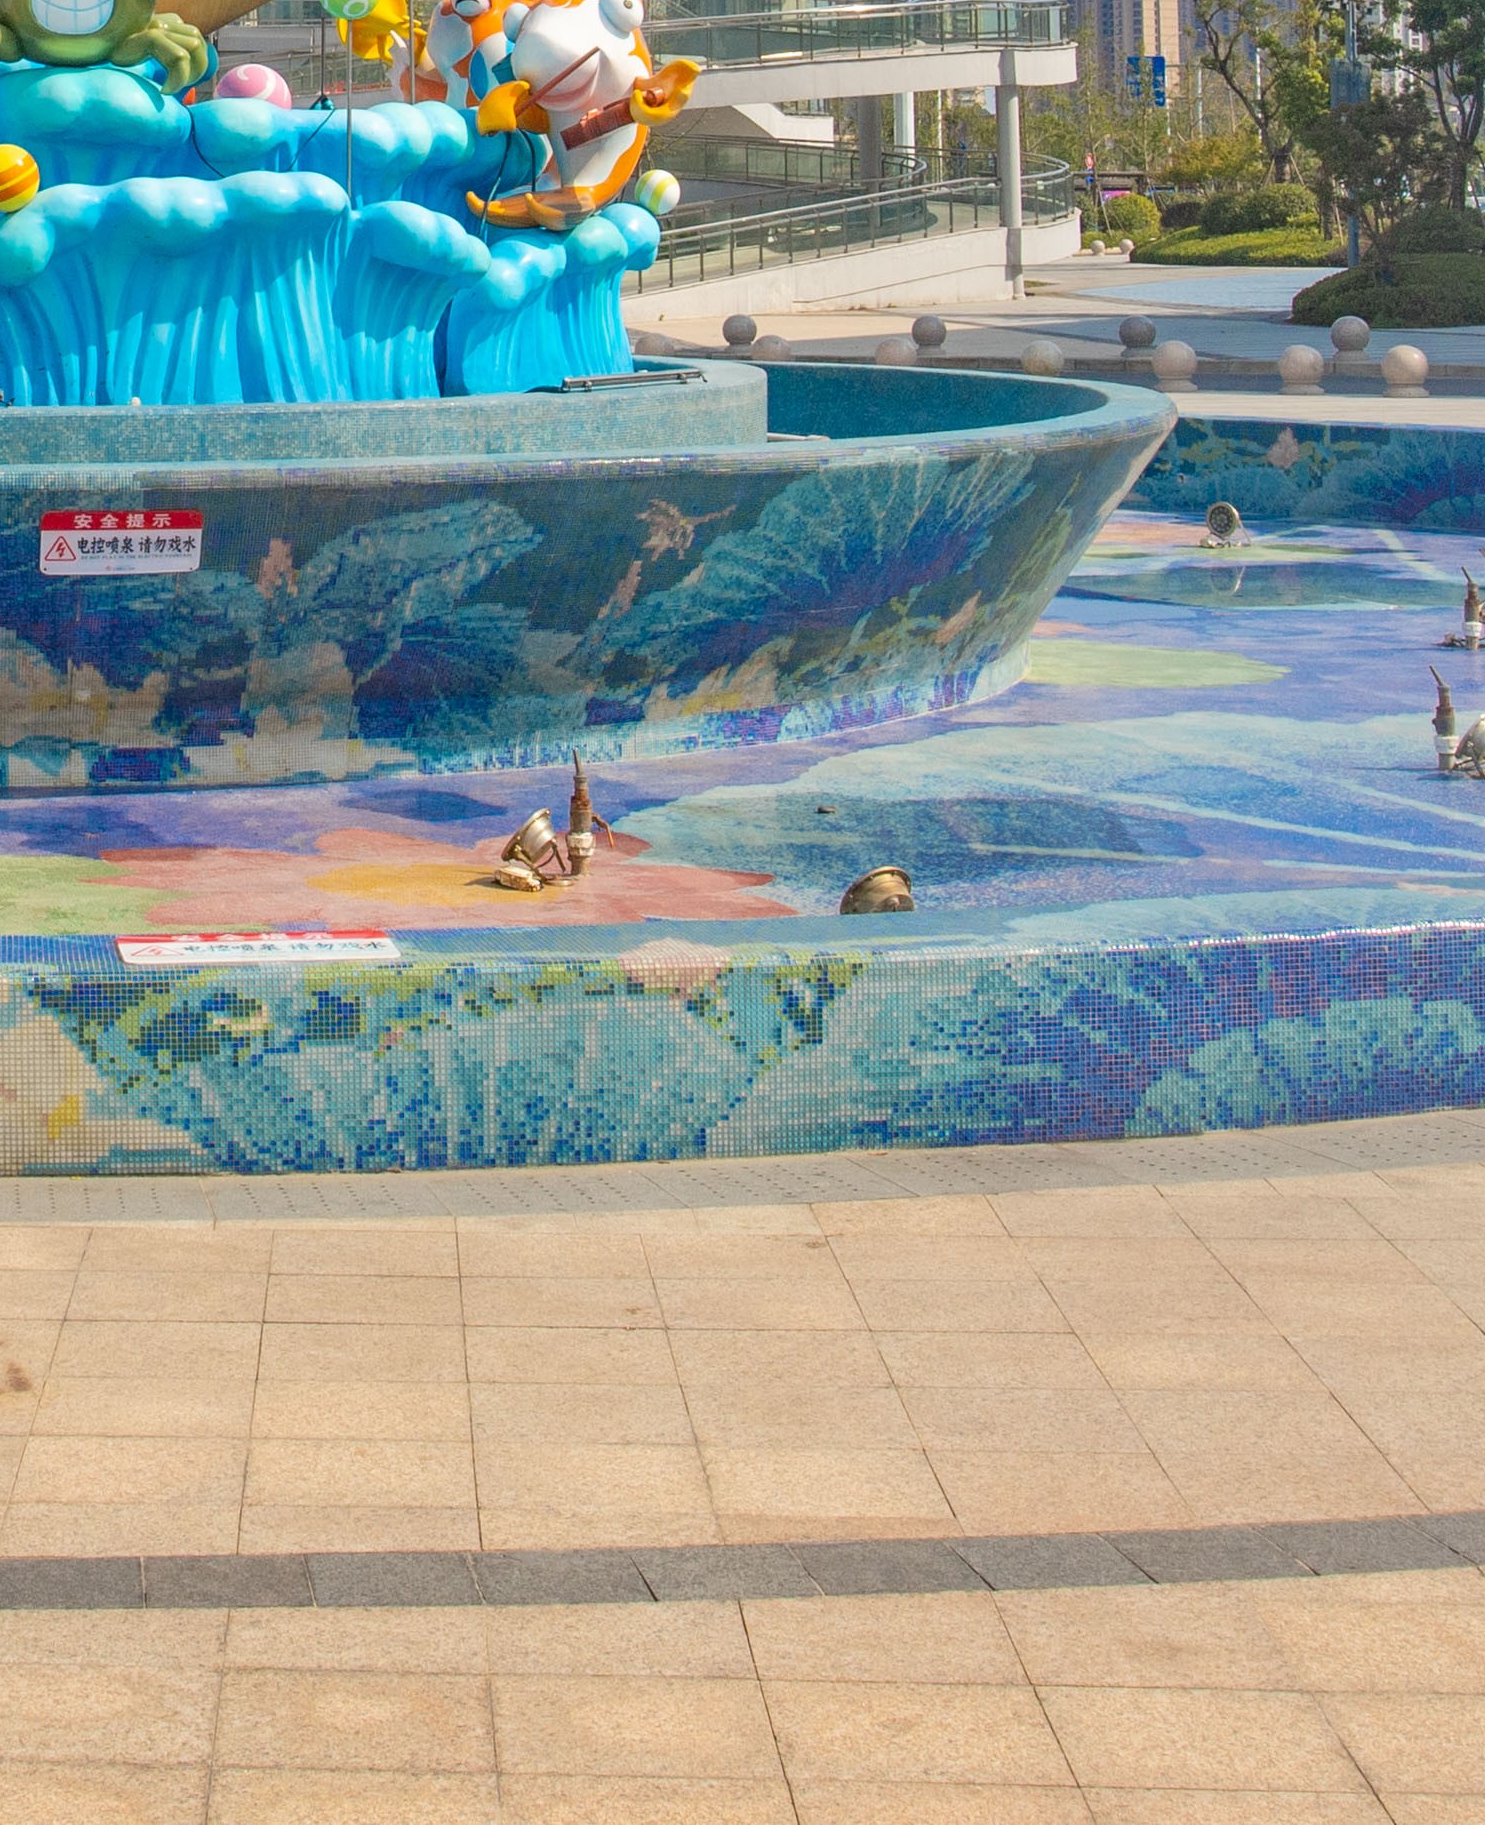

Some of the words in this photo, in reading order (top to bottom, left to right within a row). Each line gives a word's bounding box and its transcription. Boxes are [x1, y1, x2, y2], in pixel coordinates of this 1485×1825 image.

[74, 513, 172, 529] 安全提示
[77, 537, 134, 554] 电控喷泉
[138, 535, 197, 553] 请勿戏水
